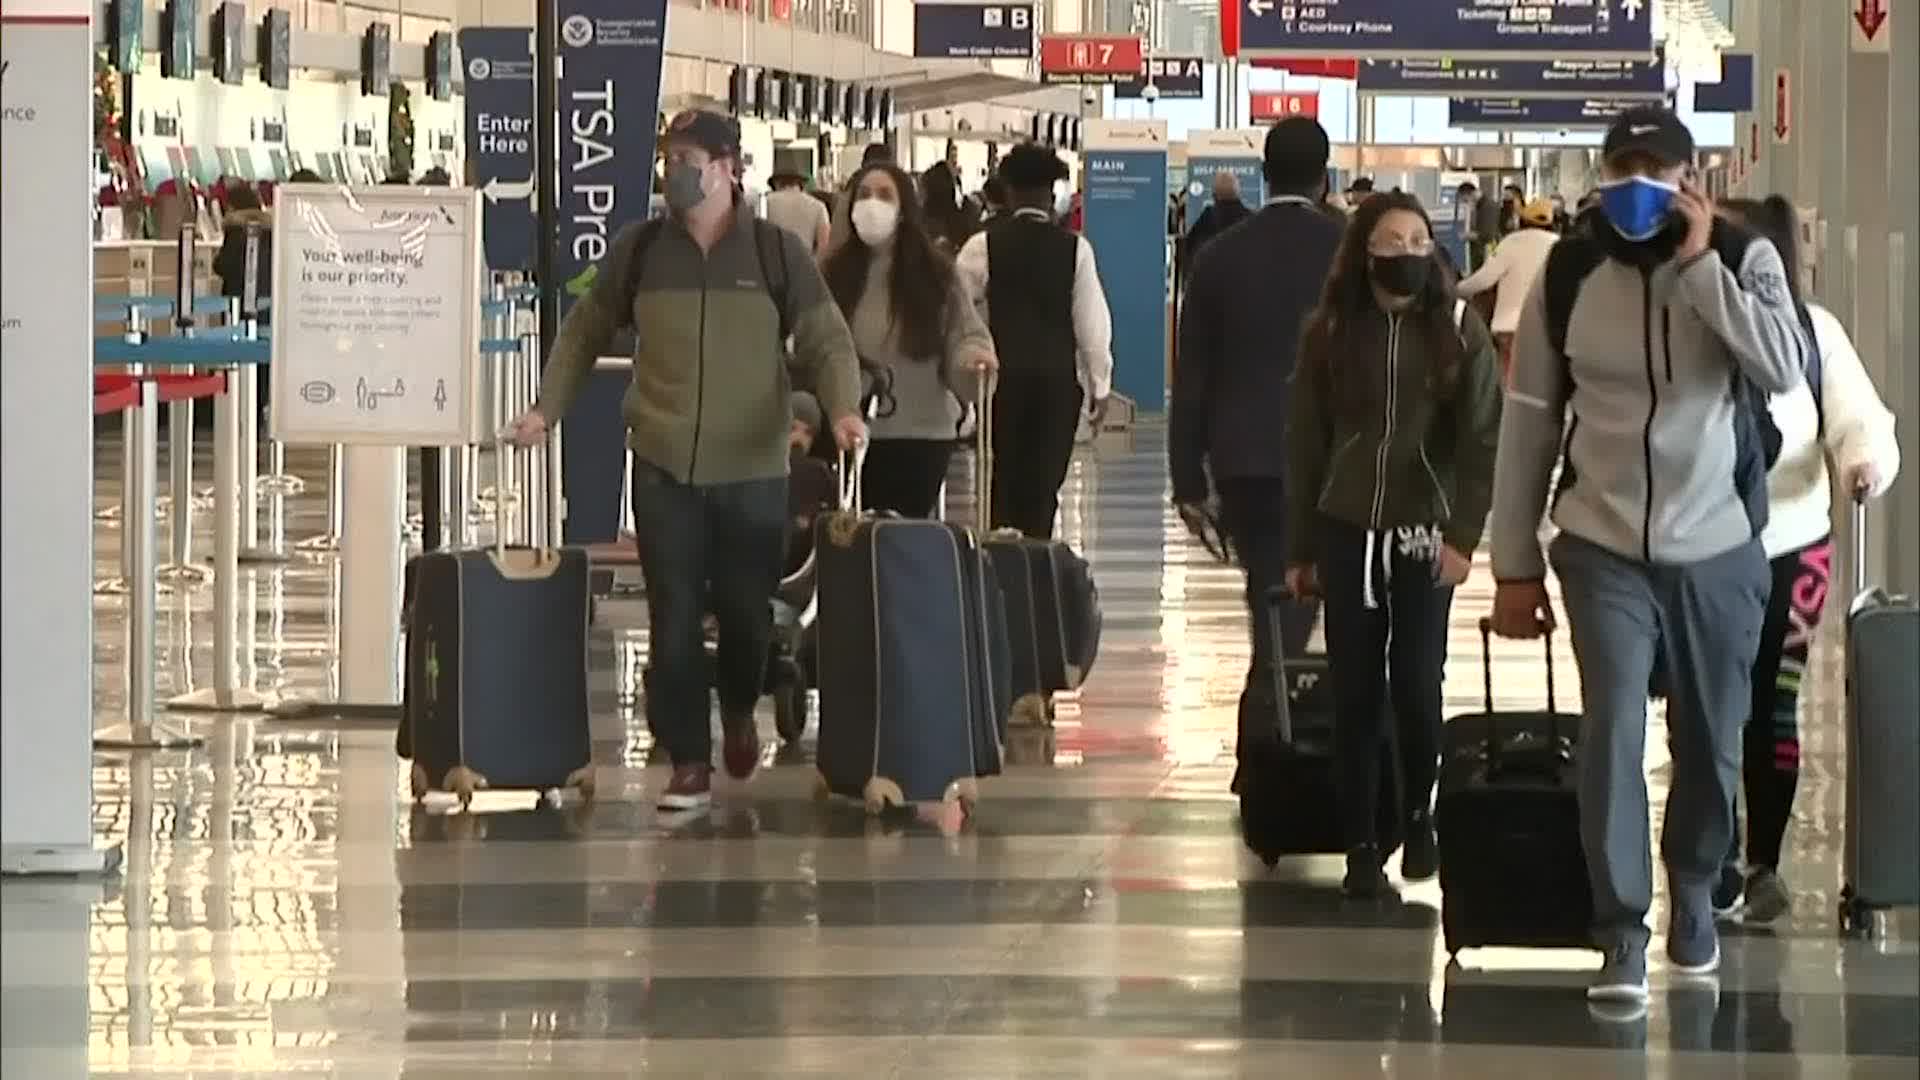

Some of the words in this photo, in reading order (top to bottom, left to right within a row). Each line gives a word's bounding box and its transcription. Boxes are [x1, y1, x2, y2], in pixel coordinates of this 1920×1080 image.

[1011, 8, 1029, 29] B
[1300, 7, 1326, 19] AED
[1299, 22, 1352, 34] Courtesy
[1355, 22, 1392, 32] Phone
[1099, 44, 1114, 66] 7
[1186, 61, 1200, 77] A
[1289, 97, 1301, 113] 6
[1, 107, 36, 121] nce
[478, 113, 531, 132] Enter
[572, 80, 614, 172] TSA
[480, 134, 528, 153] Here
[1092, 160, 1125, 170] MAIN
[572, 184, 614, 261] Pre
[302, 249, 340, 263] Your
[344, 249, 423, 267] well-being
[302, 267, 313, 282] is
[318, 271, 343, 282] our
